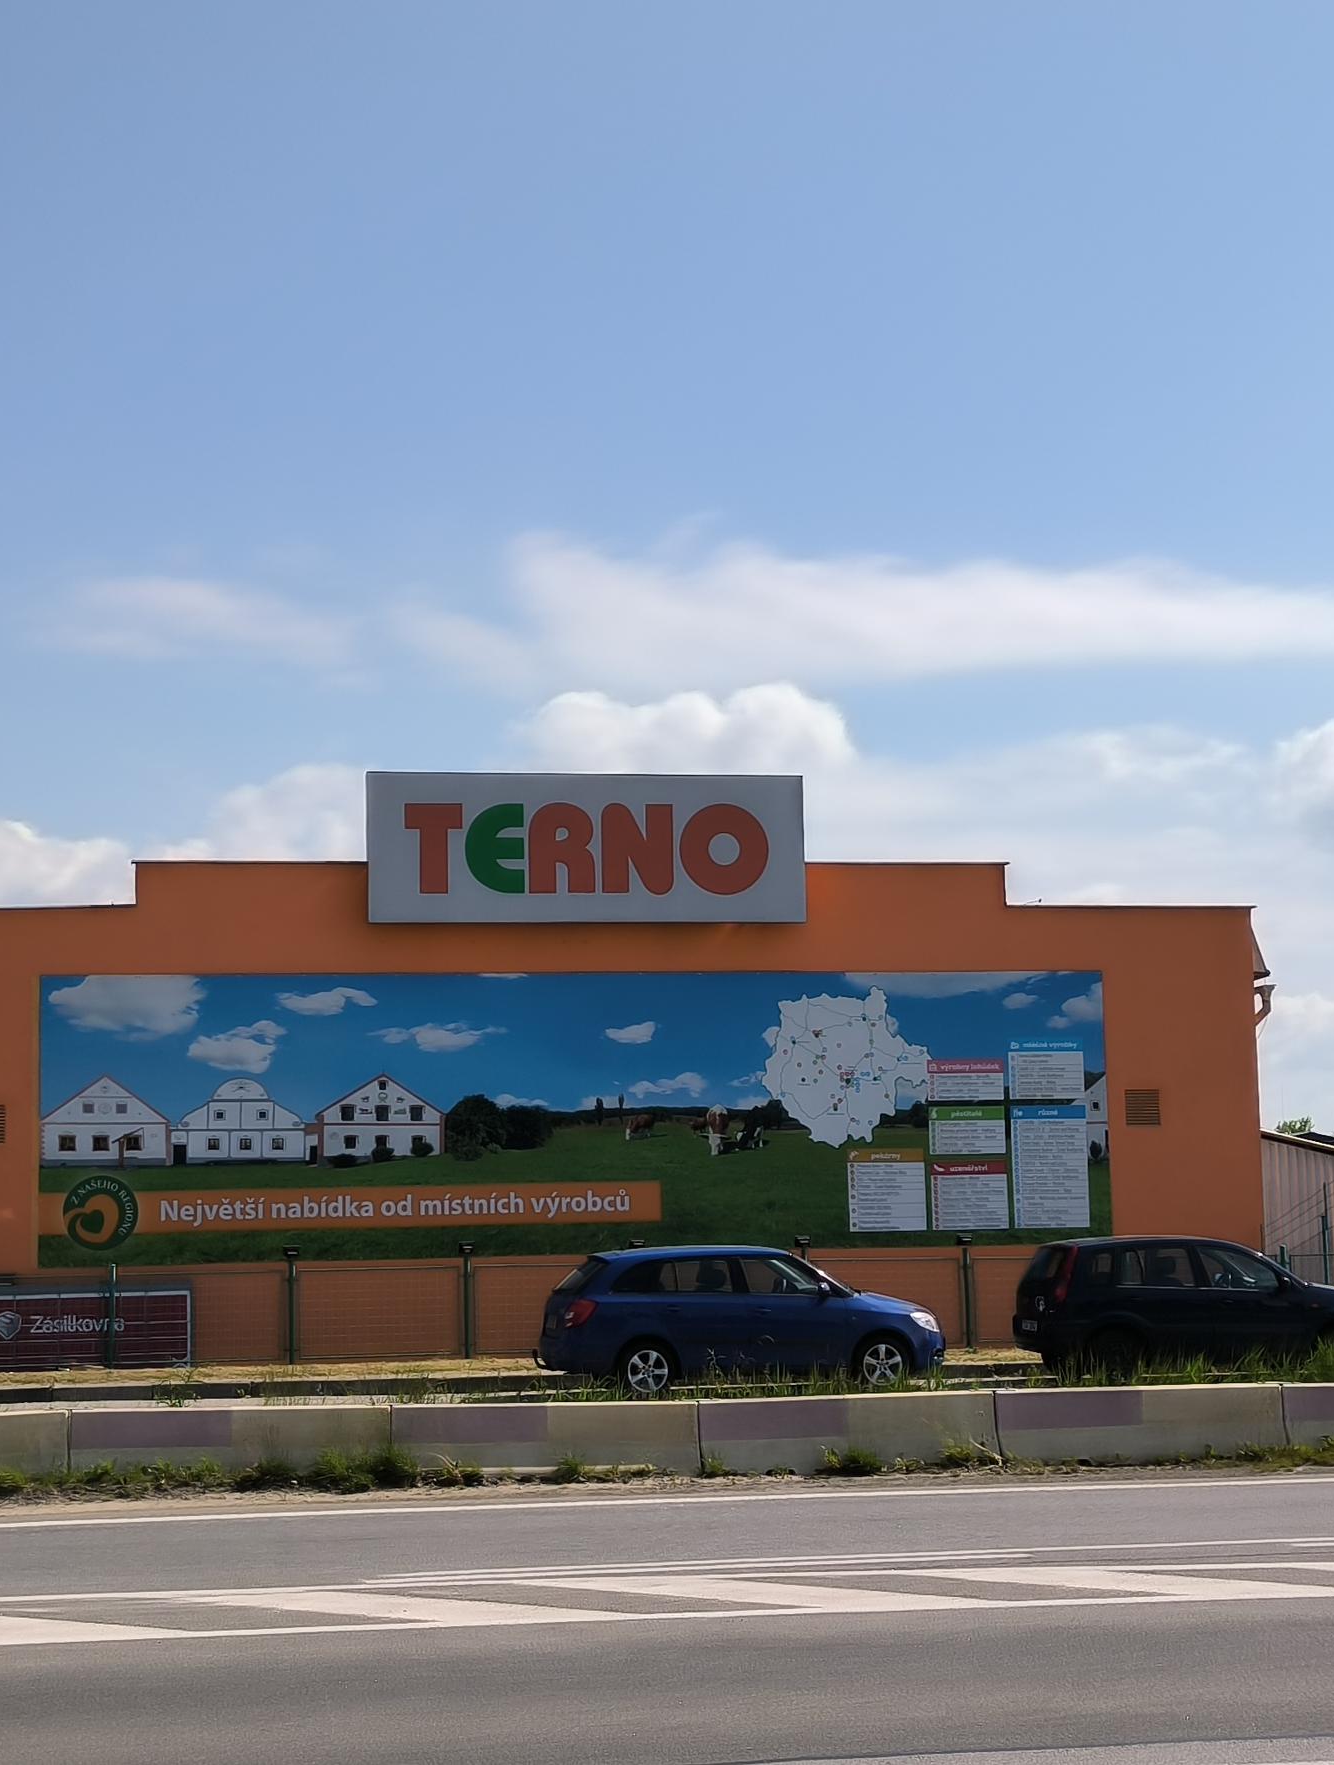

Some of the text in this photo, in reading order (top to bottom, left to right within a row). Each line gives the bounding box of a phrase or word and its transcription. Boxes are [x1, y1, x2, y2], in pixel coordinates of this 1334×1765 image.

[404, 802, 769, 895] TERNO
[160, 1189, 631, 1226] Největší nabídka od místních výrobců
